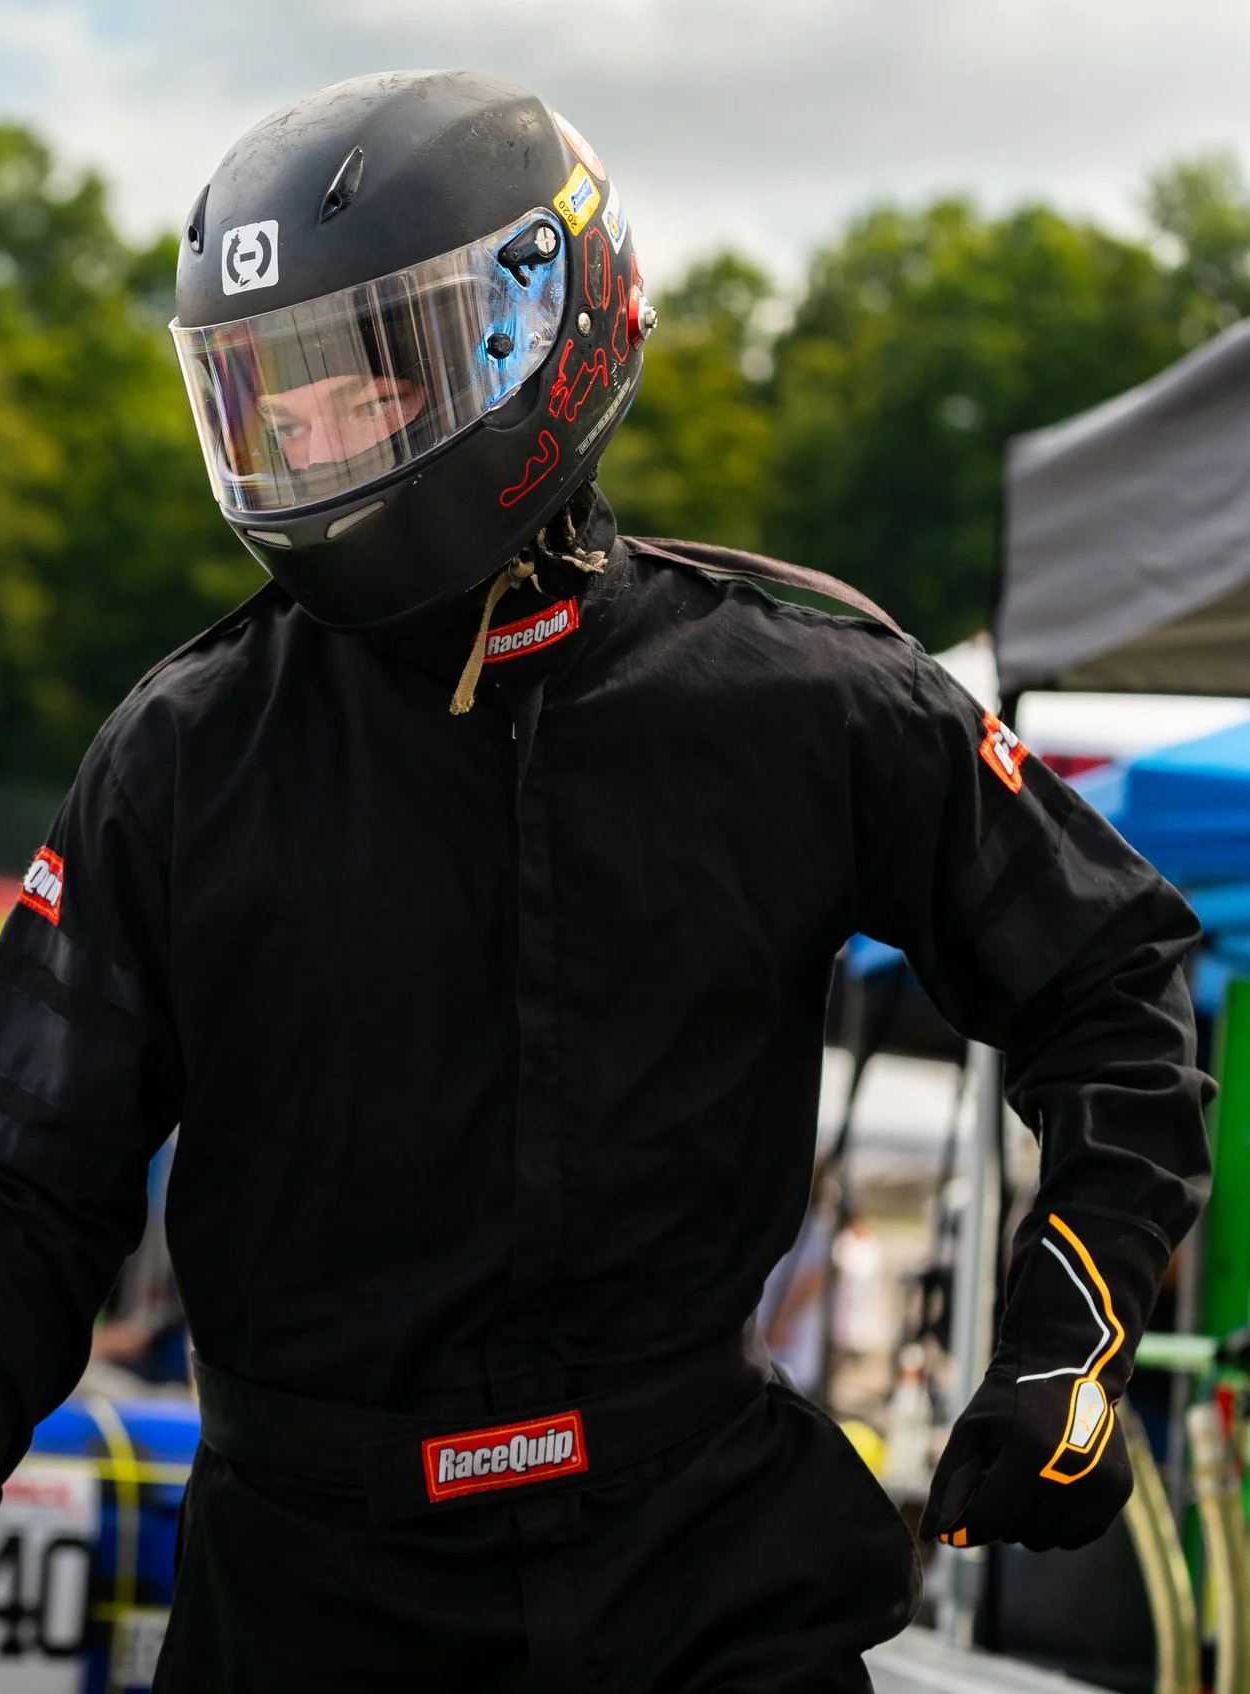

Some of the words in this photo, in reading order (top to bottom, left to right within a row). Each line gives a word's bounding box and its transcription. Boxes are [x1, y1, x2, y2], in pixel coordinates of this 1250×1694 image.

[558, 200, 578, 230] 2020
[487, 609, 569, 656] RaceQuip
[438, 1428, 573, 1483] RaceQuip
